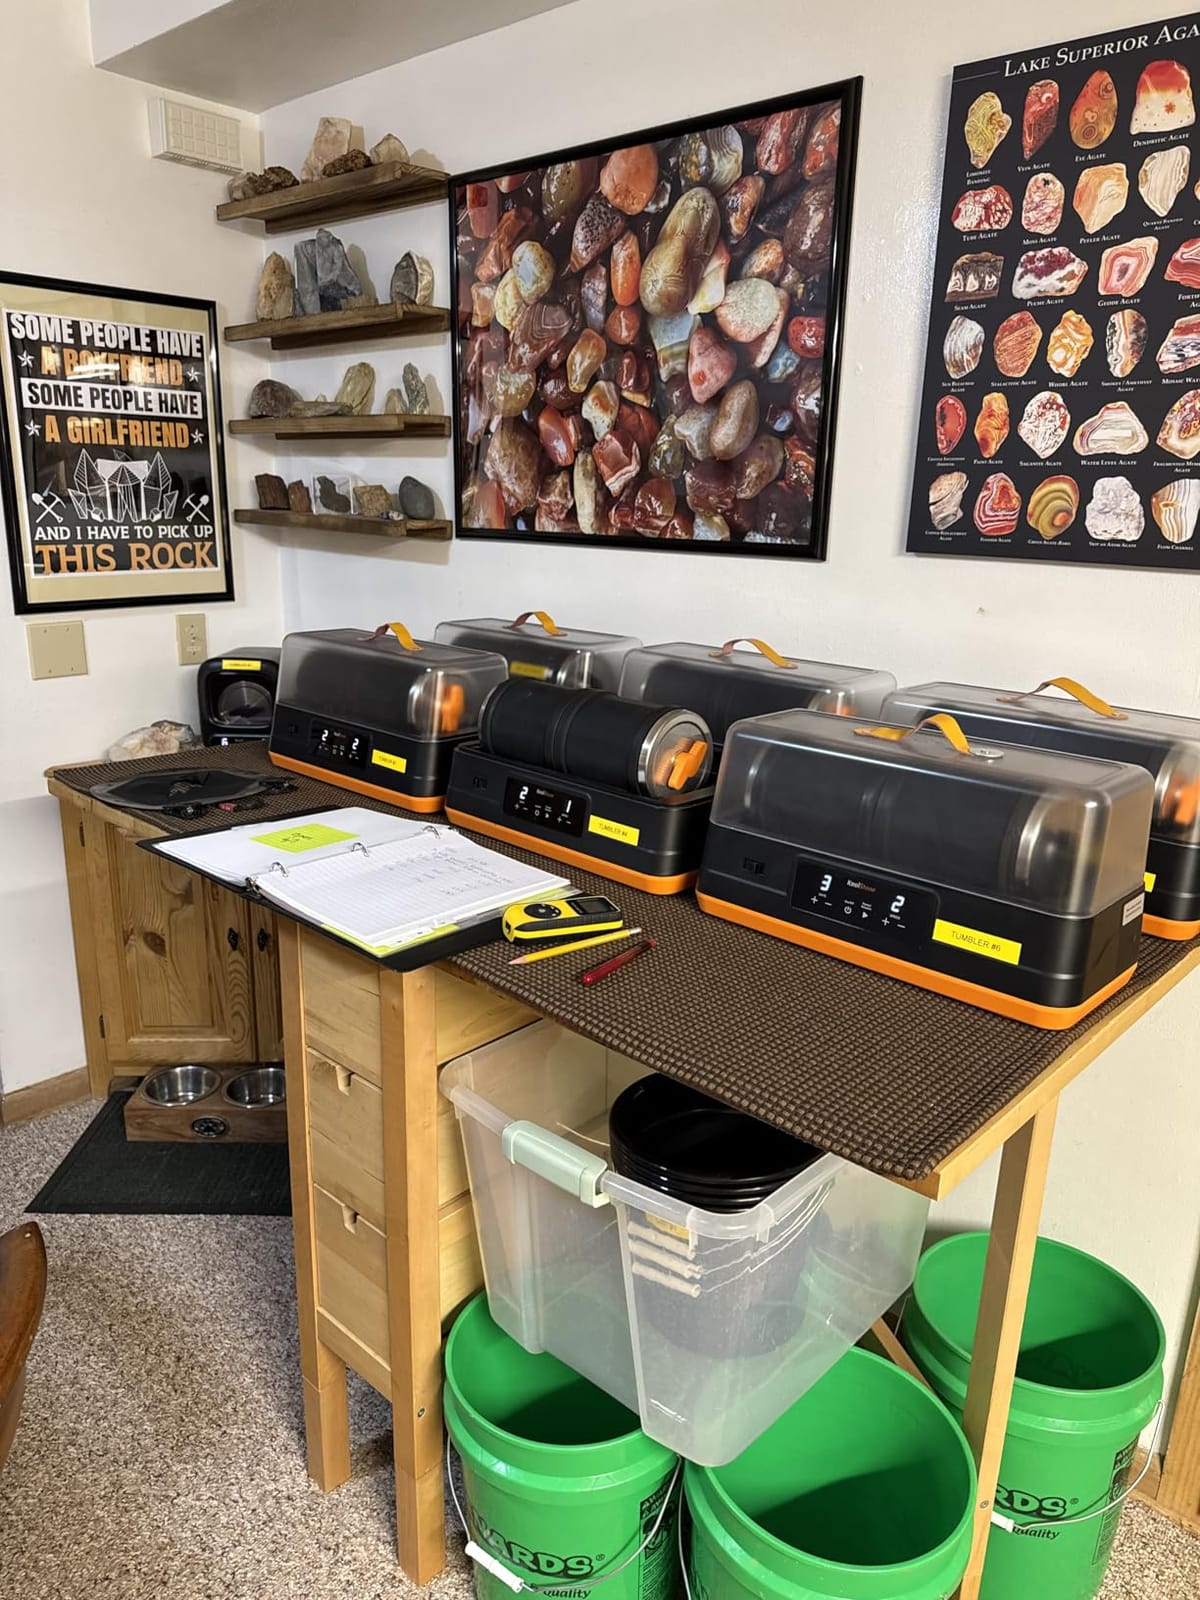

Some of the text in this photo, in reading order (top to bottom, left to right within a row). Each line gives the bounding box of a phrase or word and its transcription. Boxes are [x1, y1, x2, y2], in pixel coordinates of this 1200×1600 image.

[1004, 56, 1050, 77] LAKE
[1055, 34, 1149, 66] SUPERIOR
[1133, 133, 1190, 148] DENDRITIC AGATE
[1086, 152, 1106, 160] AGATE
[10, 313, 203, 358] SOME PEOPLE HAVE
[41, 346, 184, 386] A BOYFRIEND
[28, 382, 199, 416] SOME PEOPLE HAVE
[45, 414, 190, 449] A GIRLFRIEND
[34, 524, 214, 541] AND I HAVE TO PICK UP
[34, 541, 214, 575] THIS ROCK
[322, 730, 328, 742] 2
[352, 738, 360, 750] 2
[520, 786, 528, 800] 2
[820, 874, 832, 892] 3
[890, 896, 905, 912] 2
[952, 930, 1000, 952] TUMBLER #6
